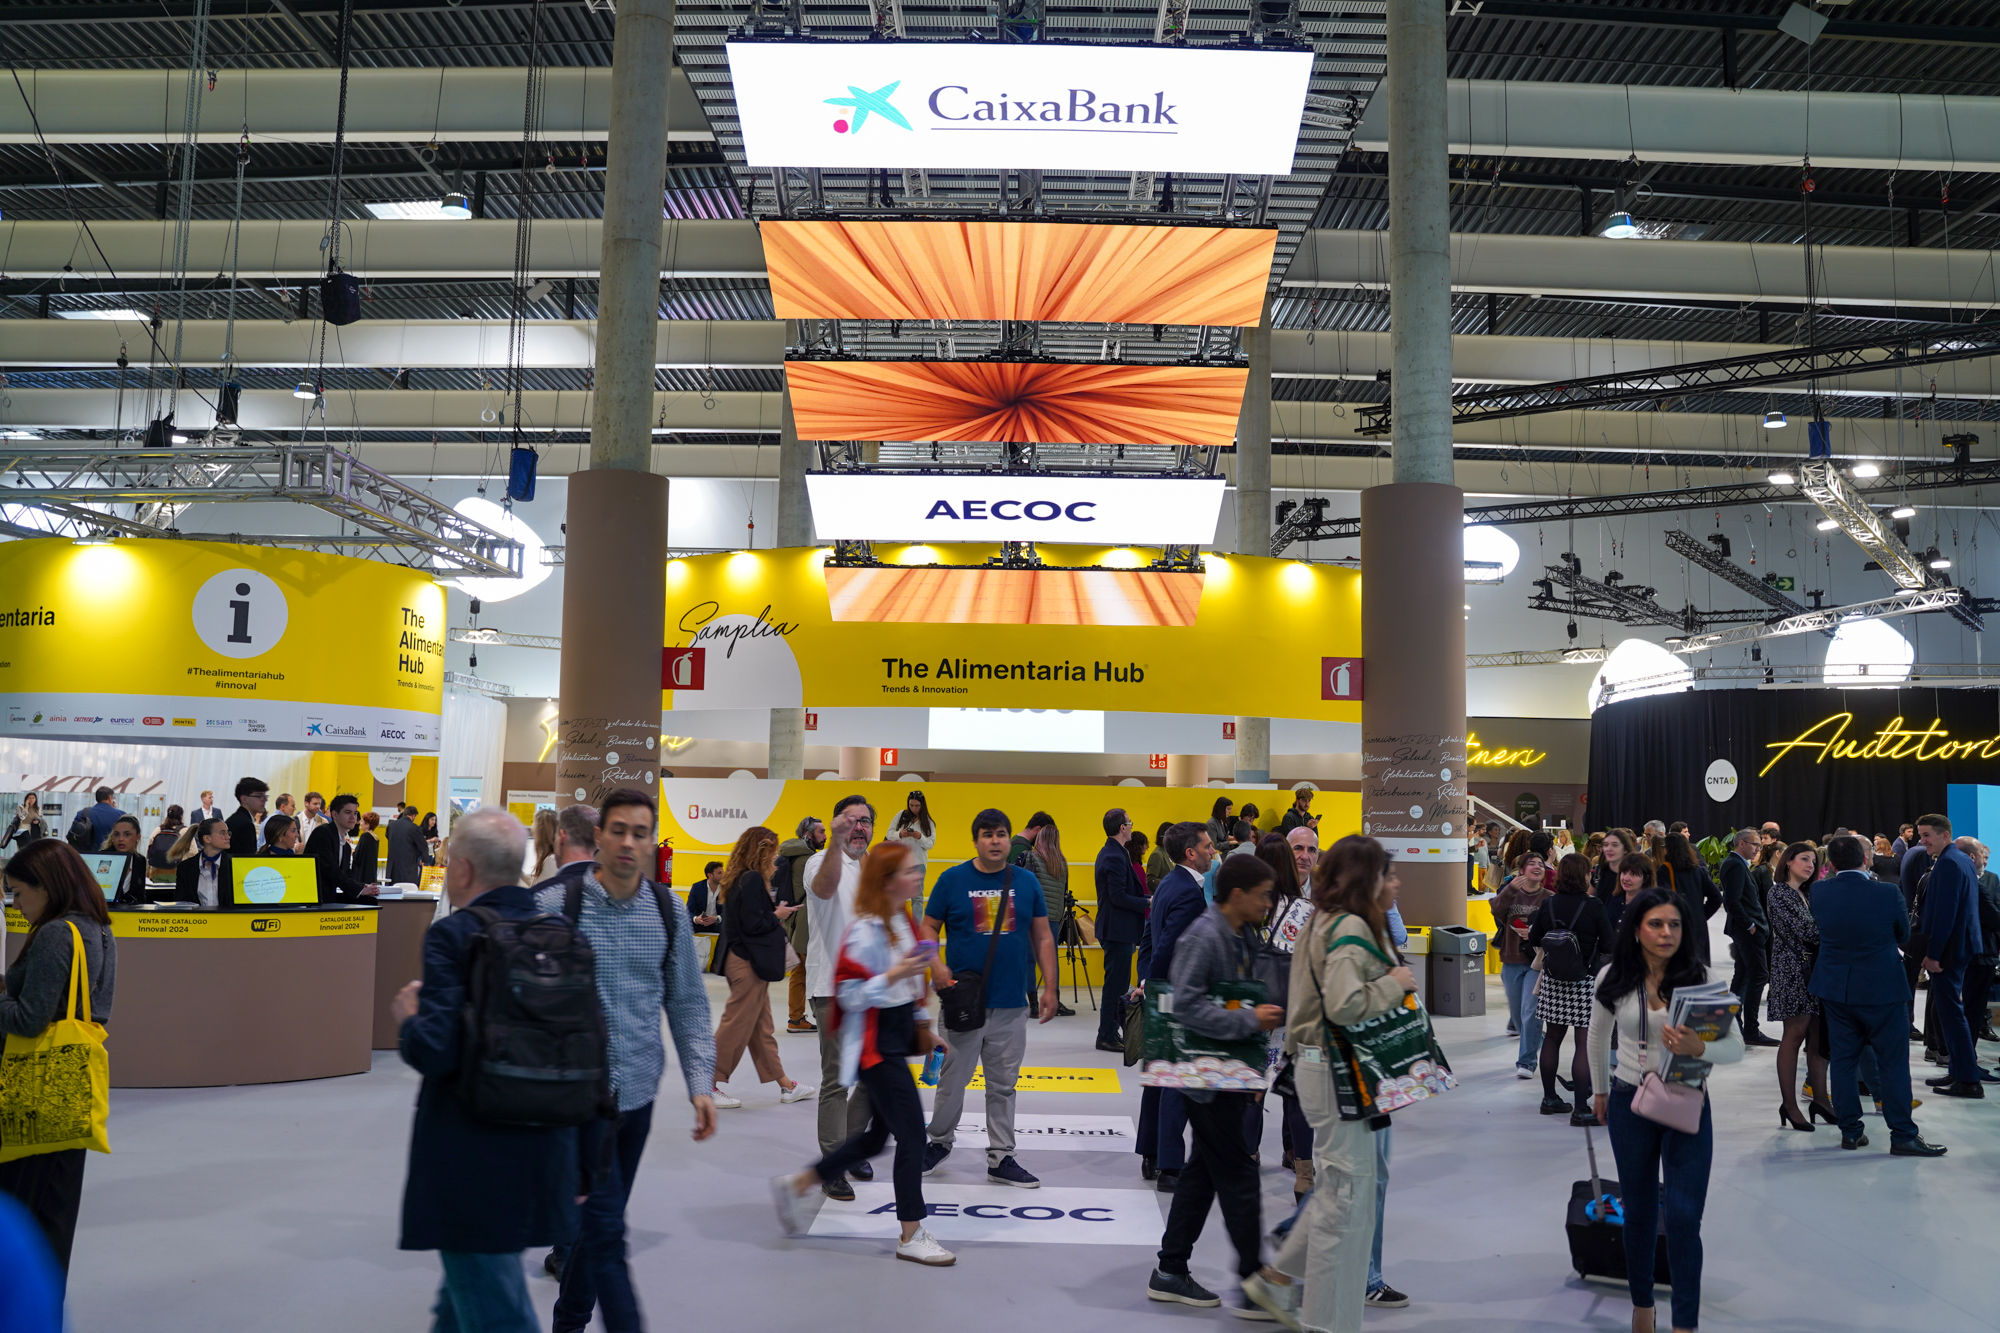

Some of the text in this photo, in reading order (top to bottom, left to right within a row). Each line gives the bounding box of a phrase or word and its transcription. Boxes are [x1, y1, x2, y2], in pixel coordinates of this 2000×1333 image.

[927, 85, 1179, 125] CaixaBank
[925, 500, 1097, 522] AECOC
[401, 607, 425, 628] The
[676, 601, 800, 659] Samplia
[398, 653, 424, 674] Hub
[881, 658, 1145, 683] The Alimentaria Hub
[187, 667, 285, 681] #Thealimentariahub
[215, 680, 257, 690] #innoval
[397, 679, 413, 688] Trends
[881, 685, 968, 694] Trends & Innovation
[325, 723, 367, 736] CaixaBank
[380, 729, 406, 740] AECOC
[565, 730, 597, 748] Salud
[1391, 747, 1431, 765] Salud
[601, 766, 642, 784] Retail
[1706, 776, 1729, 785] CNTA
[1366, 785, 1425, 799] Distribución
[1437, 783, 1465, 800] Retail
[701, 808, 748, 819] SAMPLIA
[171, 917, 208, 925] CATÁLOGO
